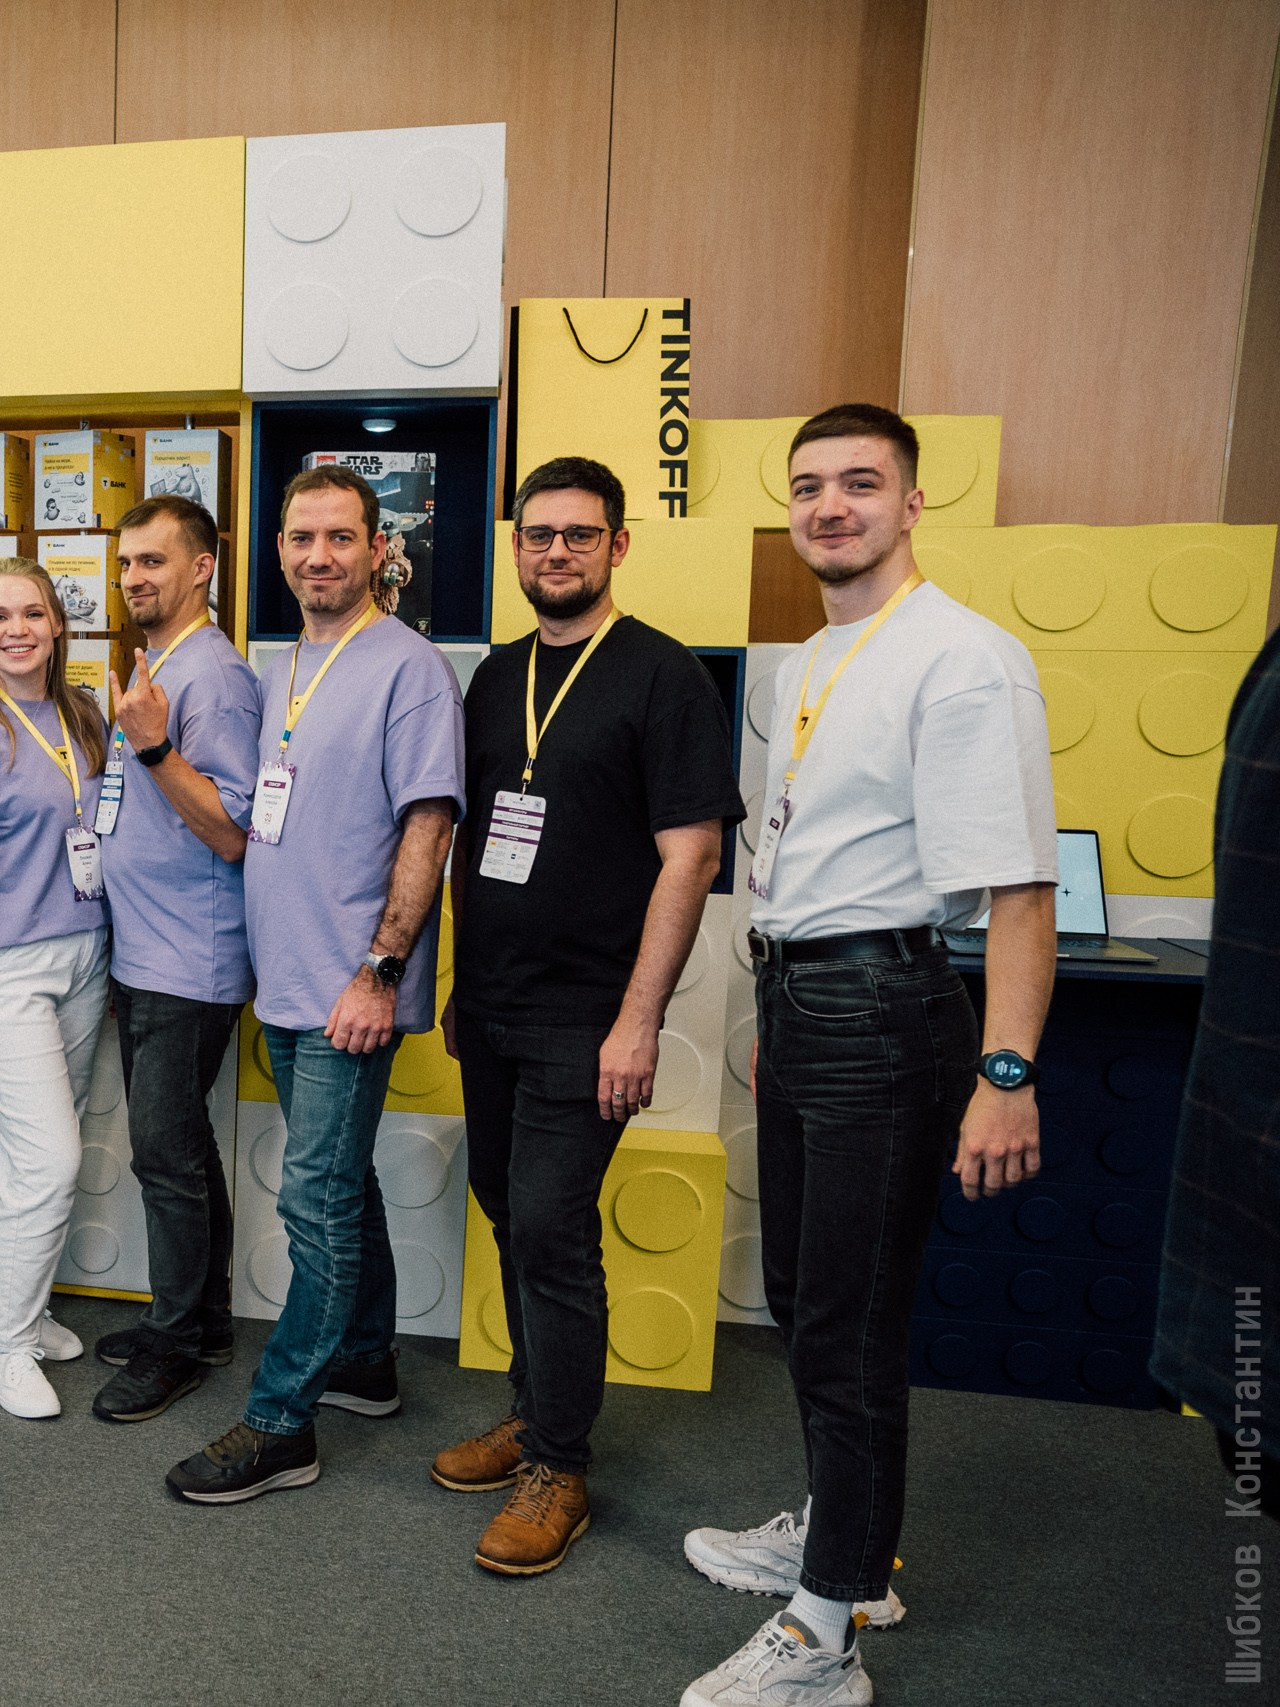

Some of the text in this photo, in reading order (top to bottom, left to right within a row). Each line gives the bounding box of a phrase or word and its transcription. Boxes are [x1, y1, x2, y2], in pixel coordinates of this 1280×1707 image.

[658, 297, 690, 518] TINKOFF
[340, 455, 383, 466] STAR
[350, 465, 383, 475] ARS
